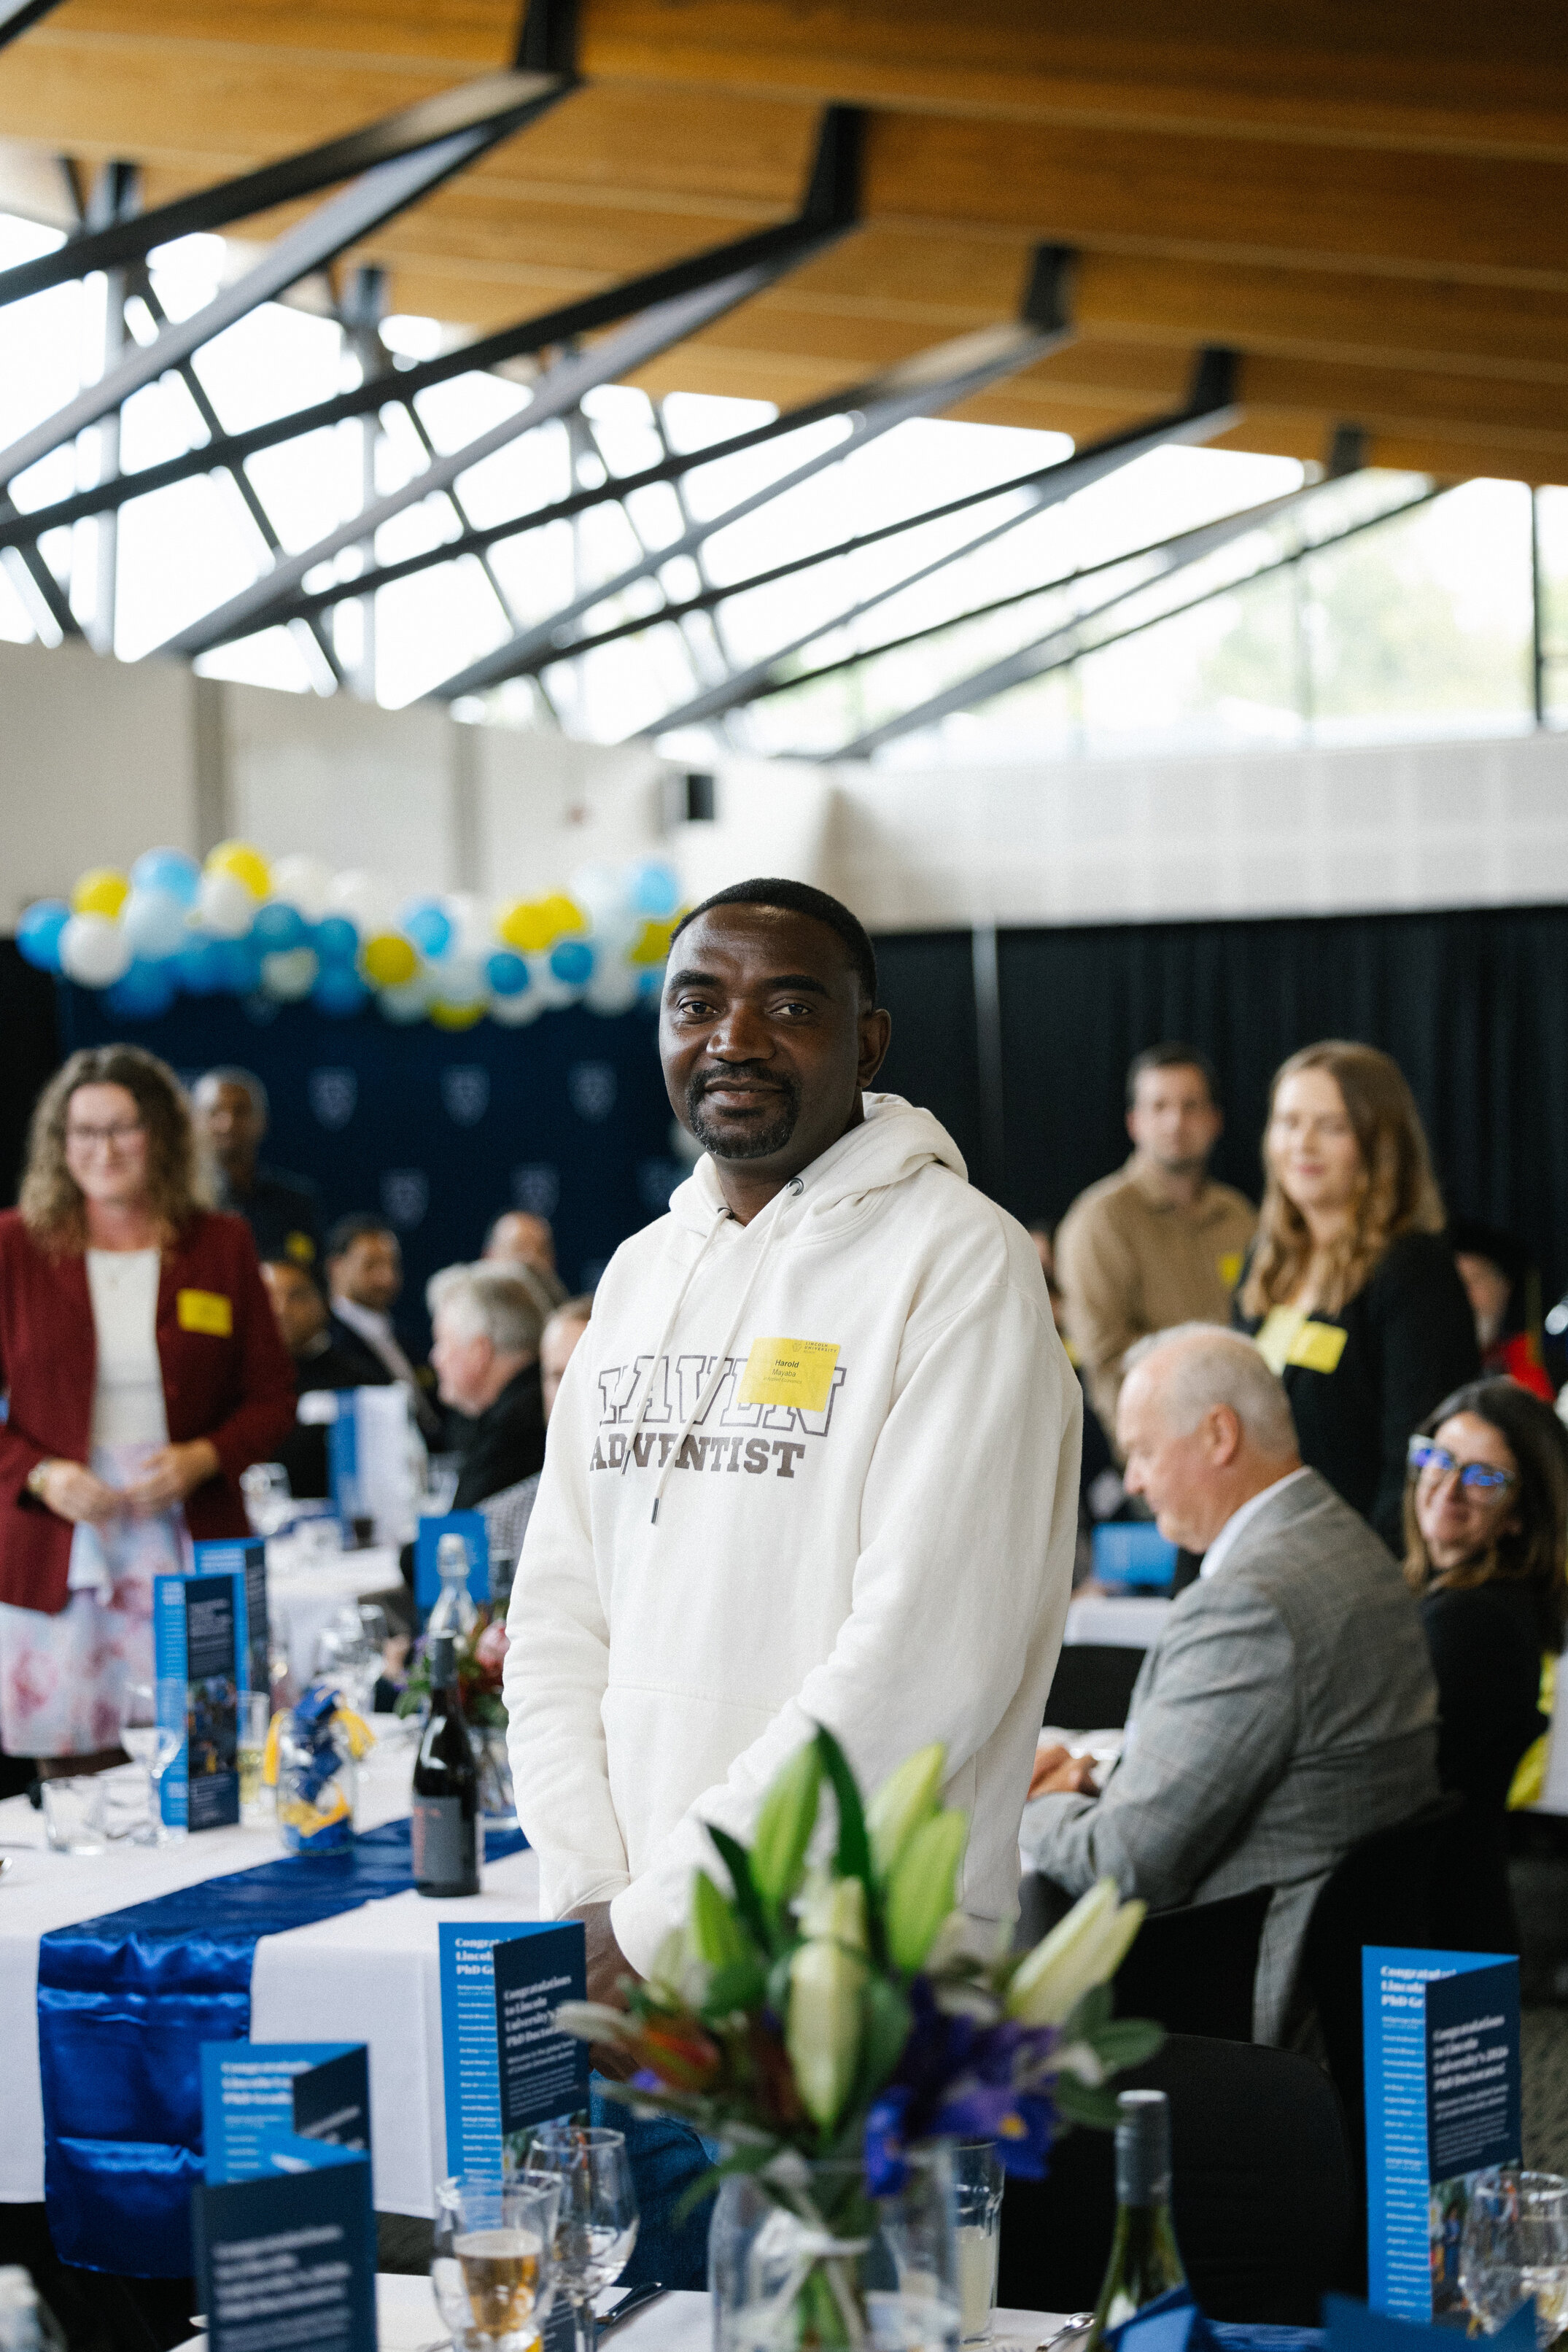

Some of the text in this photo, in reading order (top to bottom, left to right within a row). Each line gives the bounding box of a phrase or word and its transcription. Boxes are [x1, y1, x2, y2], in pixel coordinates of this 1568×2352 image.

[804, 1346, 837, 1354] UNIVERSITY
[775, 1359, 800, 1368] Harold
[772, 1368, 796, 1378] Mayaba
